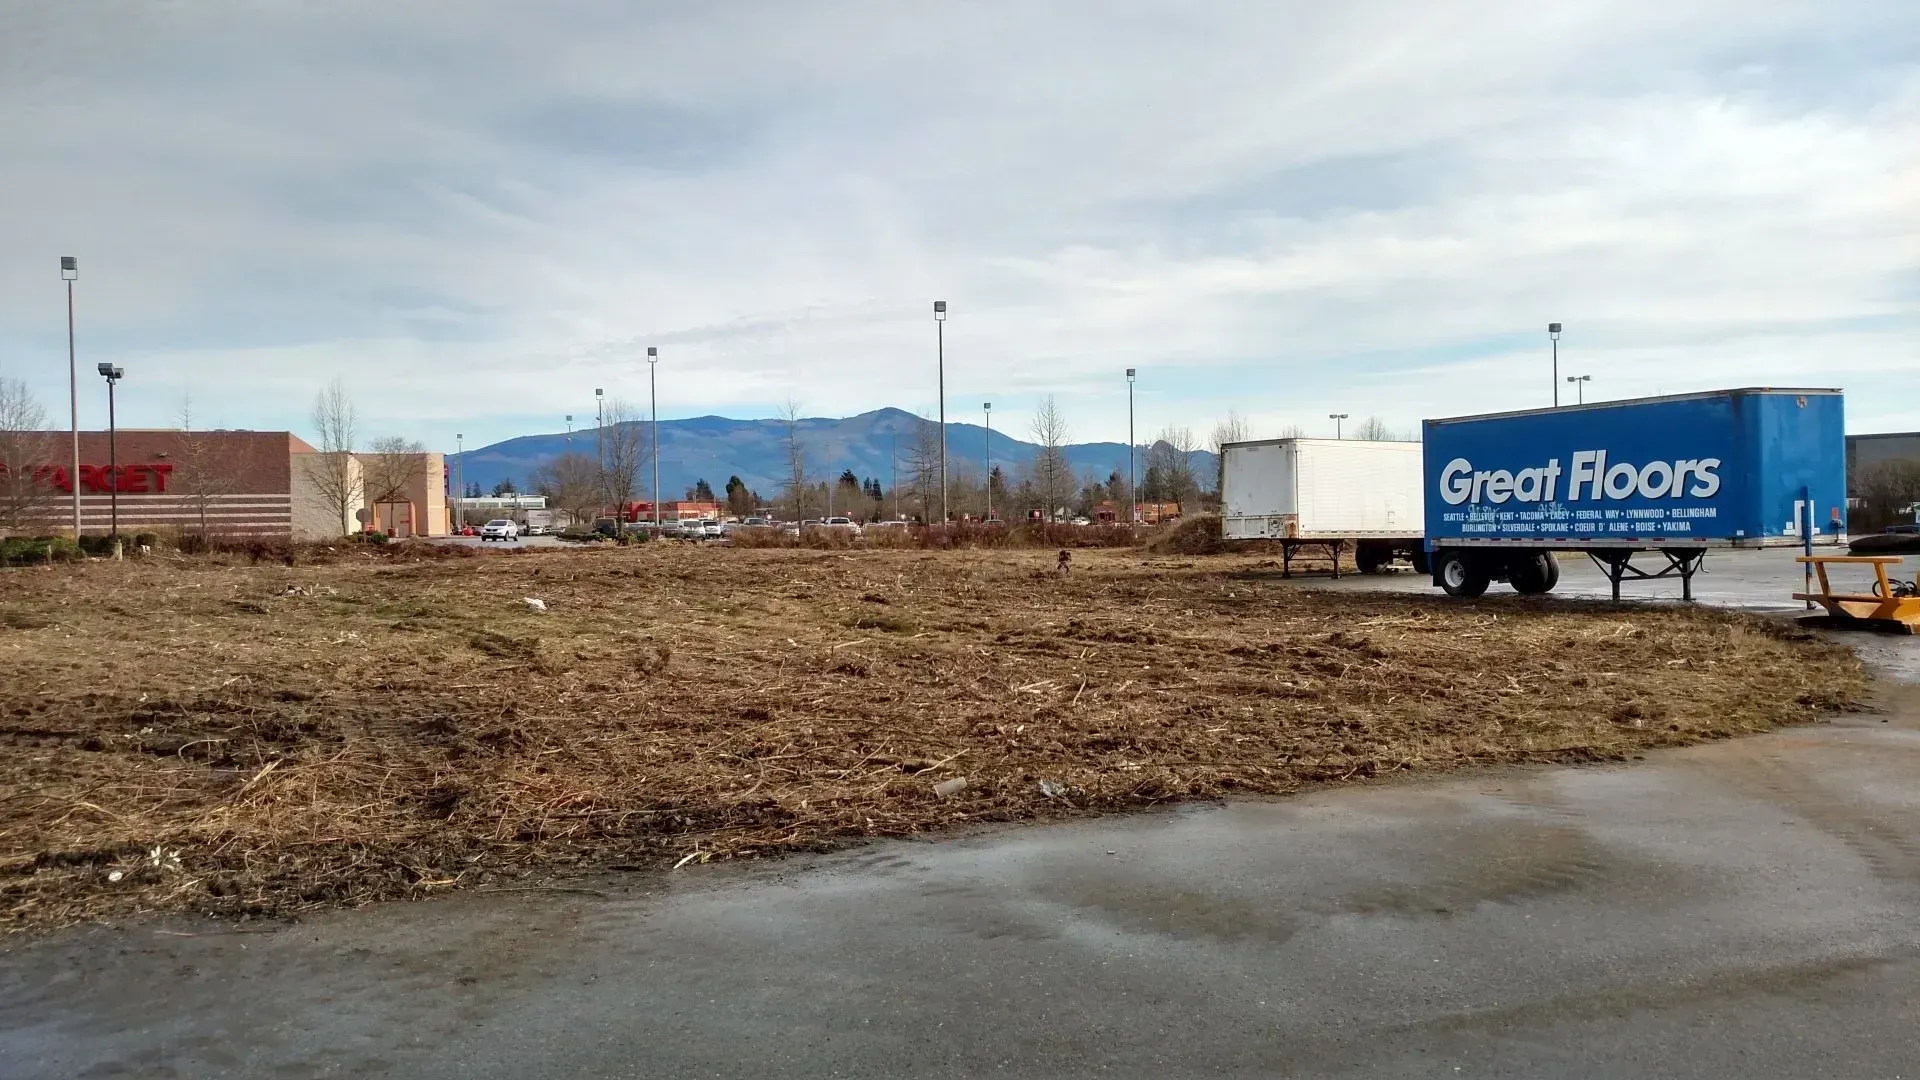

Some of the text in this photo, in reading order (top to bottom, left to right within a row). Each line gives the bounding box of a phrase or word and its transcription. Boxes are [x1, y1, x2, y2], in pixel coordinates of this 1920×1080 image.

[1440, 449, 1721, 505] Great Floors
[1443, 512, 1464, 522] SEATTLE
[1469, 512, 1495, 521] BELLEVUE
[1500, 511, 1514, 520] KENT
[1519, 511, 1545, 520] TACOMA
[1550, 510, 1570, 520] LACEY
[1576, 510, 1602, 519] FEDERAL
[1605, 509, 1620, 519] WAY
[1626, 509, 1665, 519] LYNNWOOD
[1671, 508, 1717, 518] BELLINGHAM
[1462, 523, 1497, 532] BURLINGTON
[1502, 523, 1535, 532] SILVERDALE
[1540, 522, 1569, 532] SPOKANE
[1574, 523, 1596, 532] COEUR
[1608, 522, 1629, 532] ALENE
[1635, 522, 1656, 532] BOISE
[1662, 521, 1692, 532] YAKIMA
